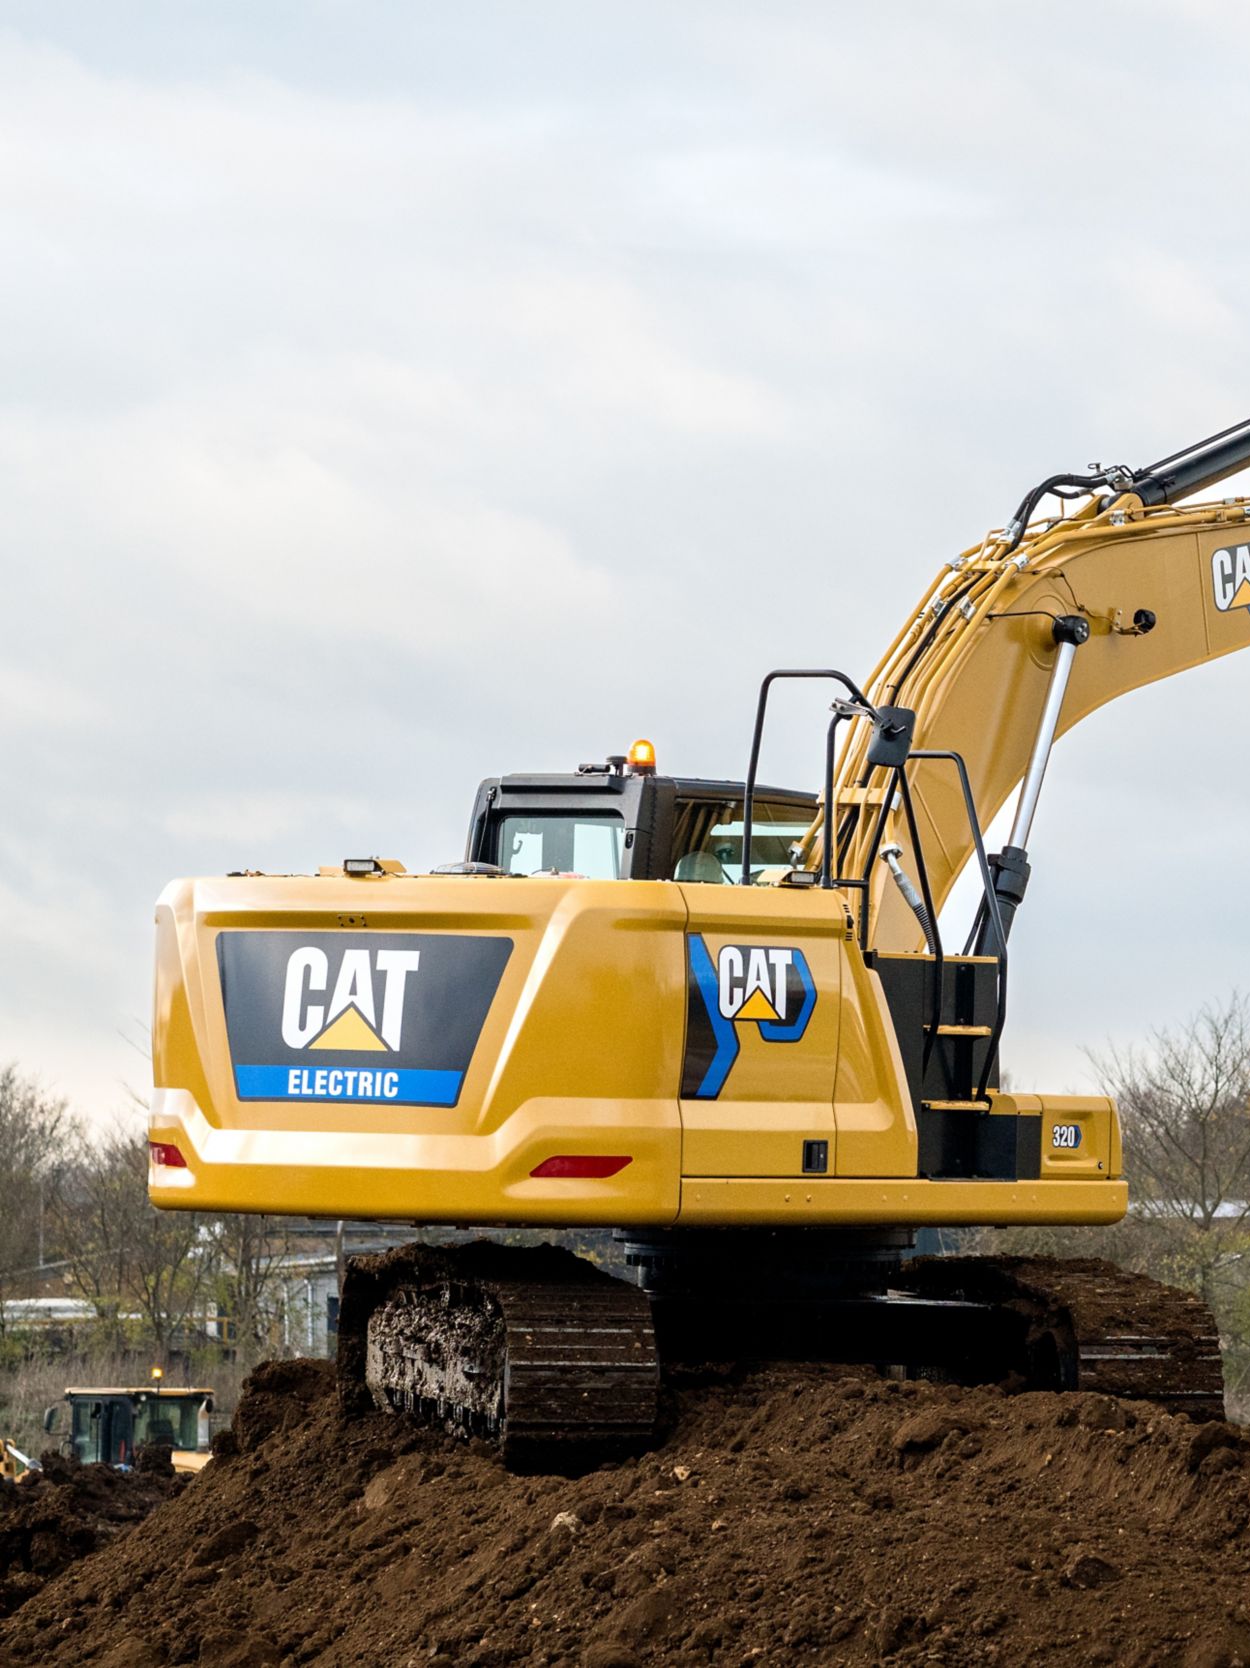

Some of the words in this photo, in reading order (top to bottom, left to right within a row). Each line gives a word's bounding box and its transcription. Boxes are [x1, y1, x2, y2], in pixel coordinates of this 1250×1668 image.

[282, 947, 420, 1051] CAT
[719, 946, 792, 1019] CAT
[288, 1069, 399, 1097] ELECTRIC
[1053, 1125, 1075, 1147] 320
